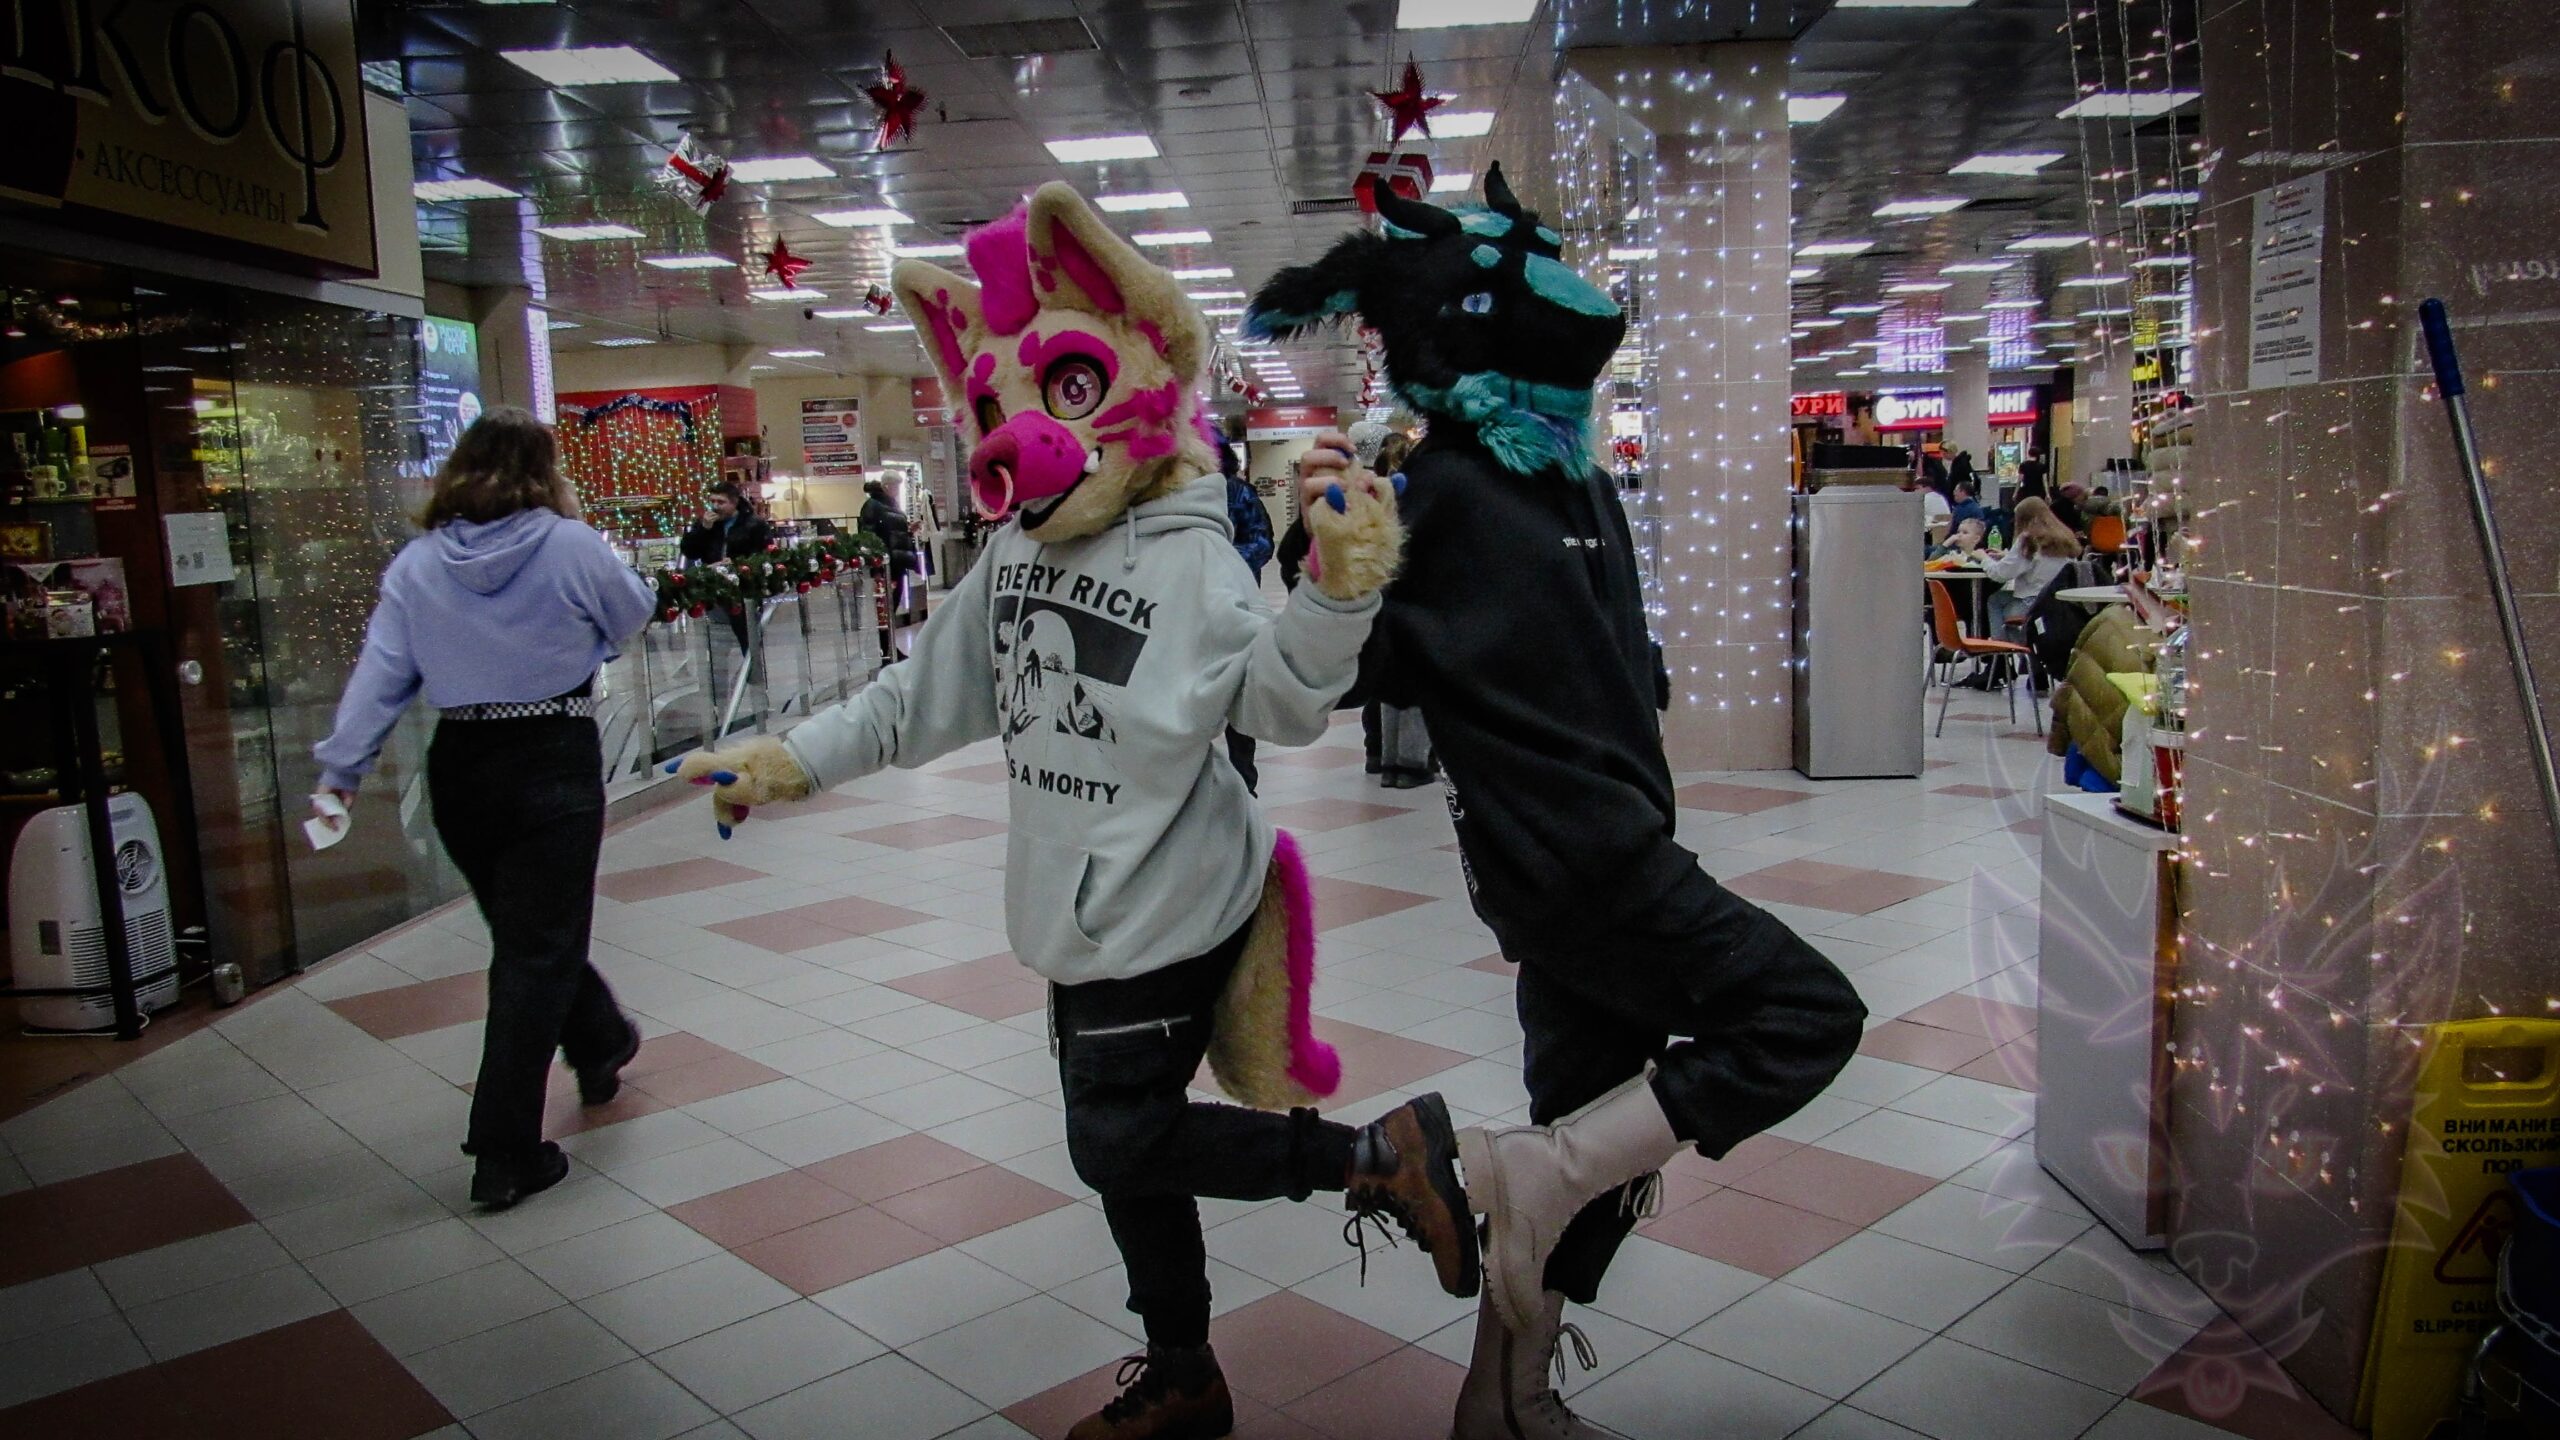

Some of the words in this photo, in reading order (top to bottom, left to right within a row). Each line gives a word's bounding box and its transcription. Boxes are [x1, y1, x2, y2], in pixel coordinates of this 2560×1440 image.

[94, 139, 287, 224] АКСЕССУАРЫ
[1793, 397, 1842, 415] УРИ
[1988, 391, 2032, 414] ИНГ
[996, 563, 1066, 595] EVERY
[1069, 574, 1158, 629] RICK
[1020, 764, 1032, 786] A
[1038, 768, 1121, 804] MORTY
[2444, 1118, 2560, 1133] ВНИМАНИЕ
[2413, 1319, 2488, 1334] SLIPPE
